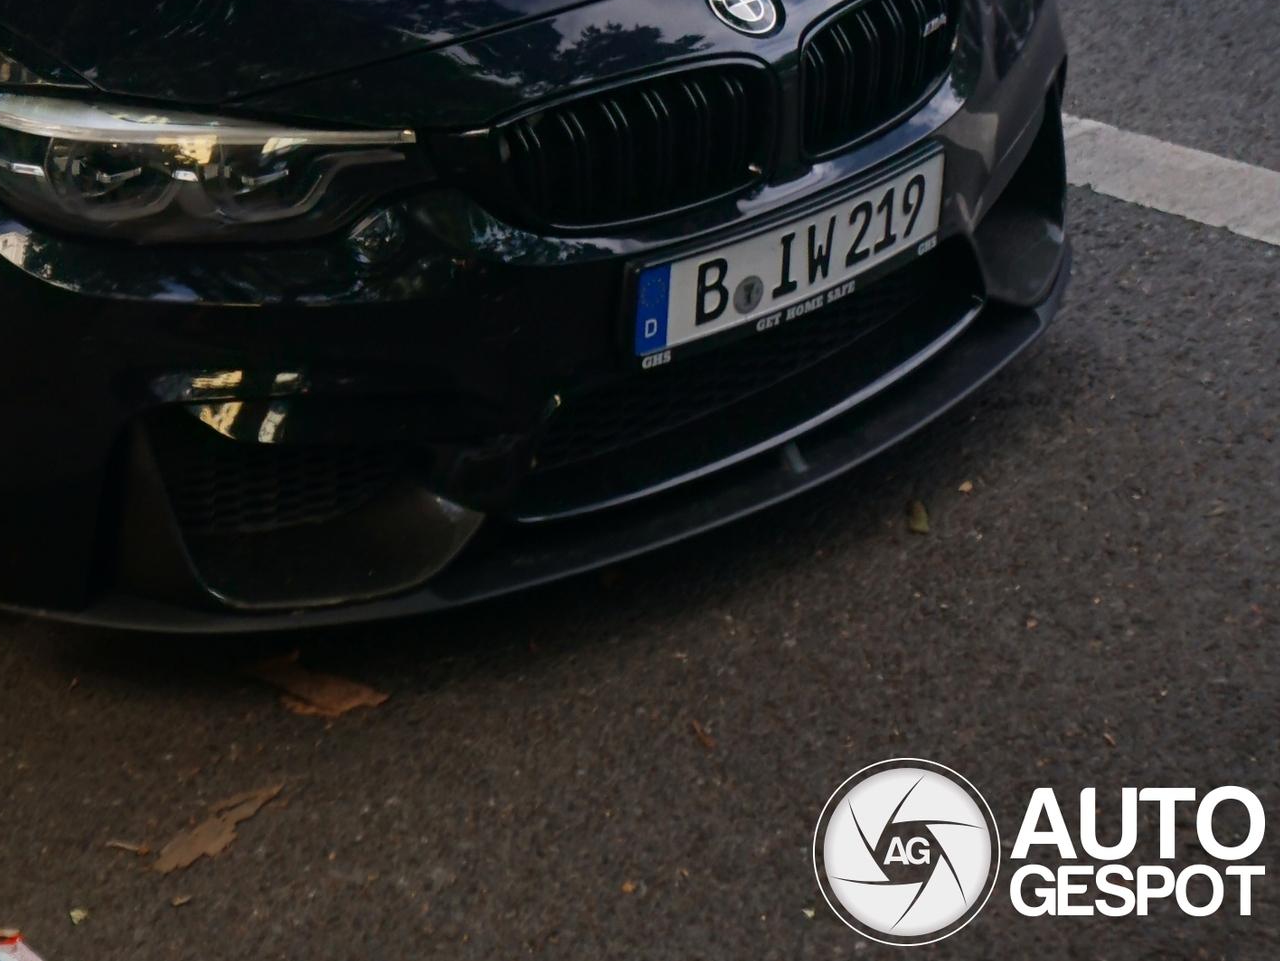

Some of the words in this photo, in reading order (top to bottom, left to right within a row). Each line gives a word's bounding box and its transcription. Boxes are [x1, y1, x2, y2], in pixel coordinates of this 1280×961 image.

[695, 257, 730, 327] B
[772, 214, 836, 299] IW
[845, 173, 925, 268] 219
[756, 312, 782, 333] GET
[786, 294, 825, 323] HOME
[827, 279, 856, 302] SAFE
[644, 318, 658, 339] D
[642, 351, 671, 370] GHS
